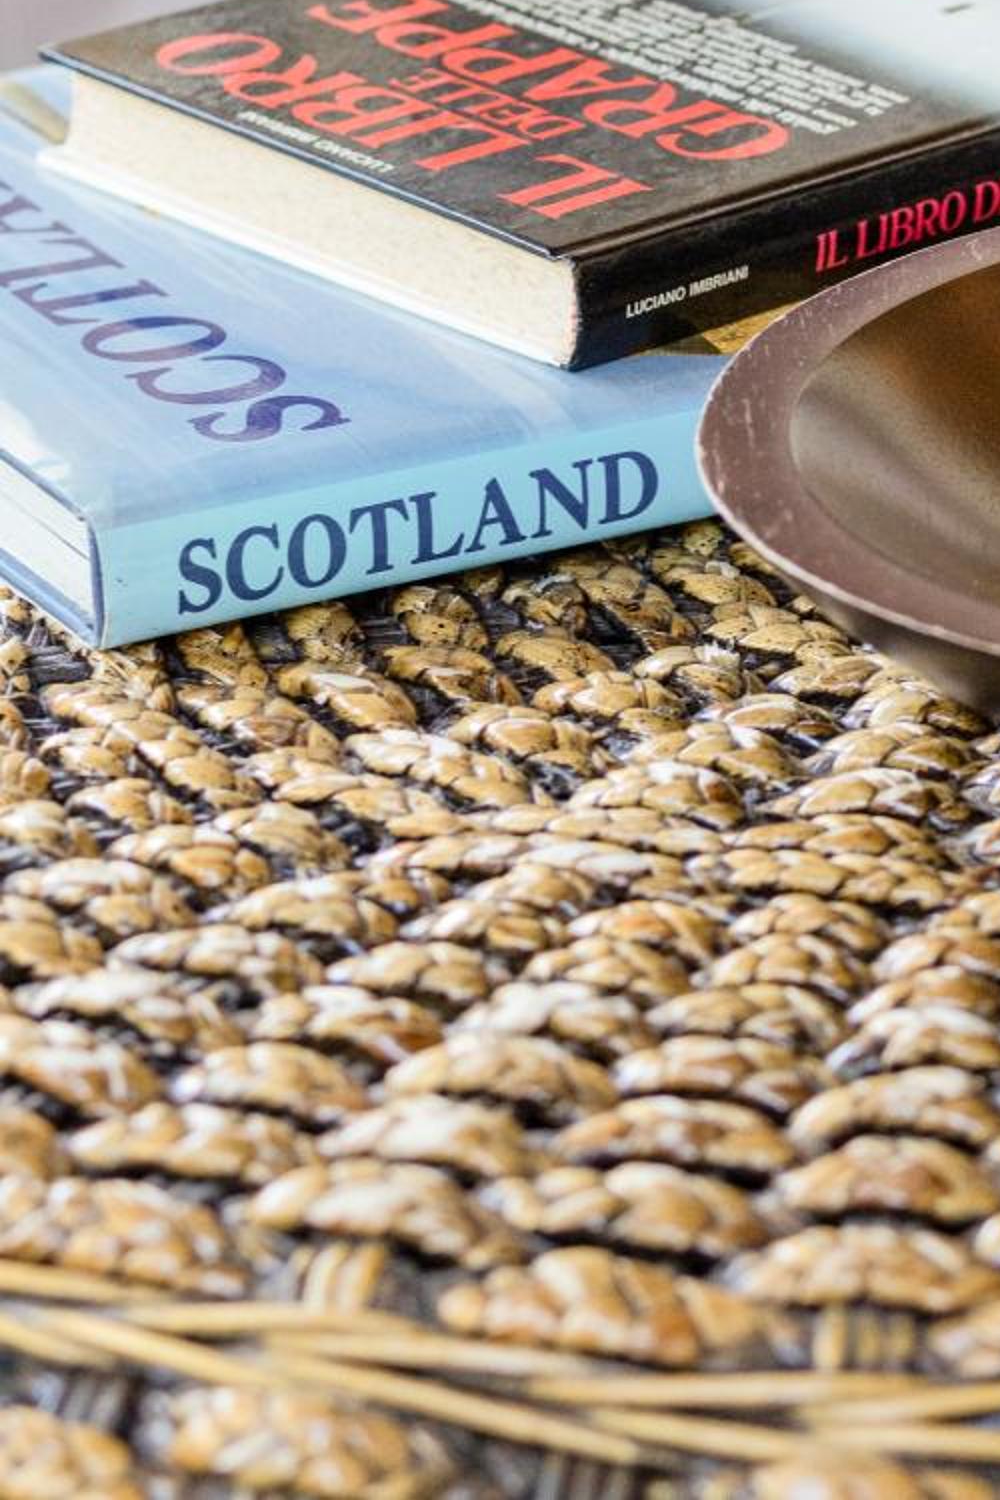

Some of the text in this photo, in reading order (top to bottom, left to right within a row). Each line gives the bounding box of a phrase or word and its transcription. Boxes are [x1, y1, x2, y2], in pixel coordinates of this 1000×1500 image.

[156, 32, 530, 172] LIBRO
[391, 67, 585, 140] DELLE
[496, 153, 654, 219] IL
[815, 229, 849, 273] IL
[856, 191, 967, 259] LIBRO
[626, 265, 749, 319] LUCIANO IMBRIANI
[177, 450, 659, 615] SCOTLAND
